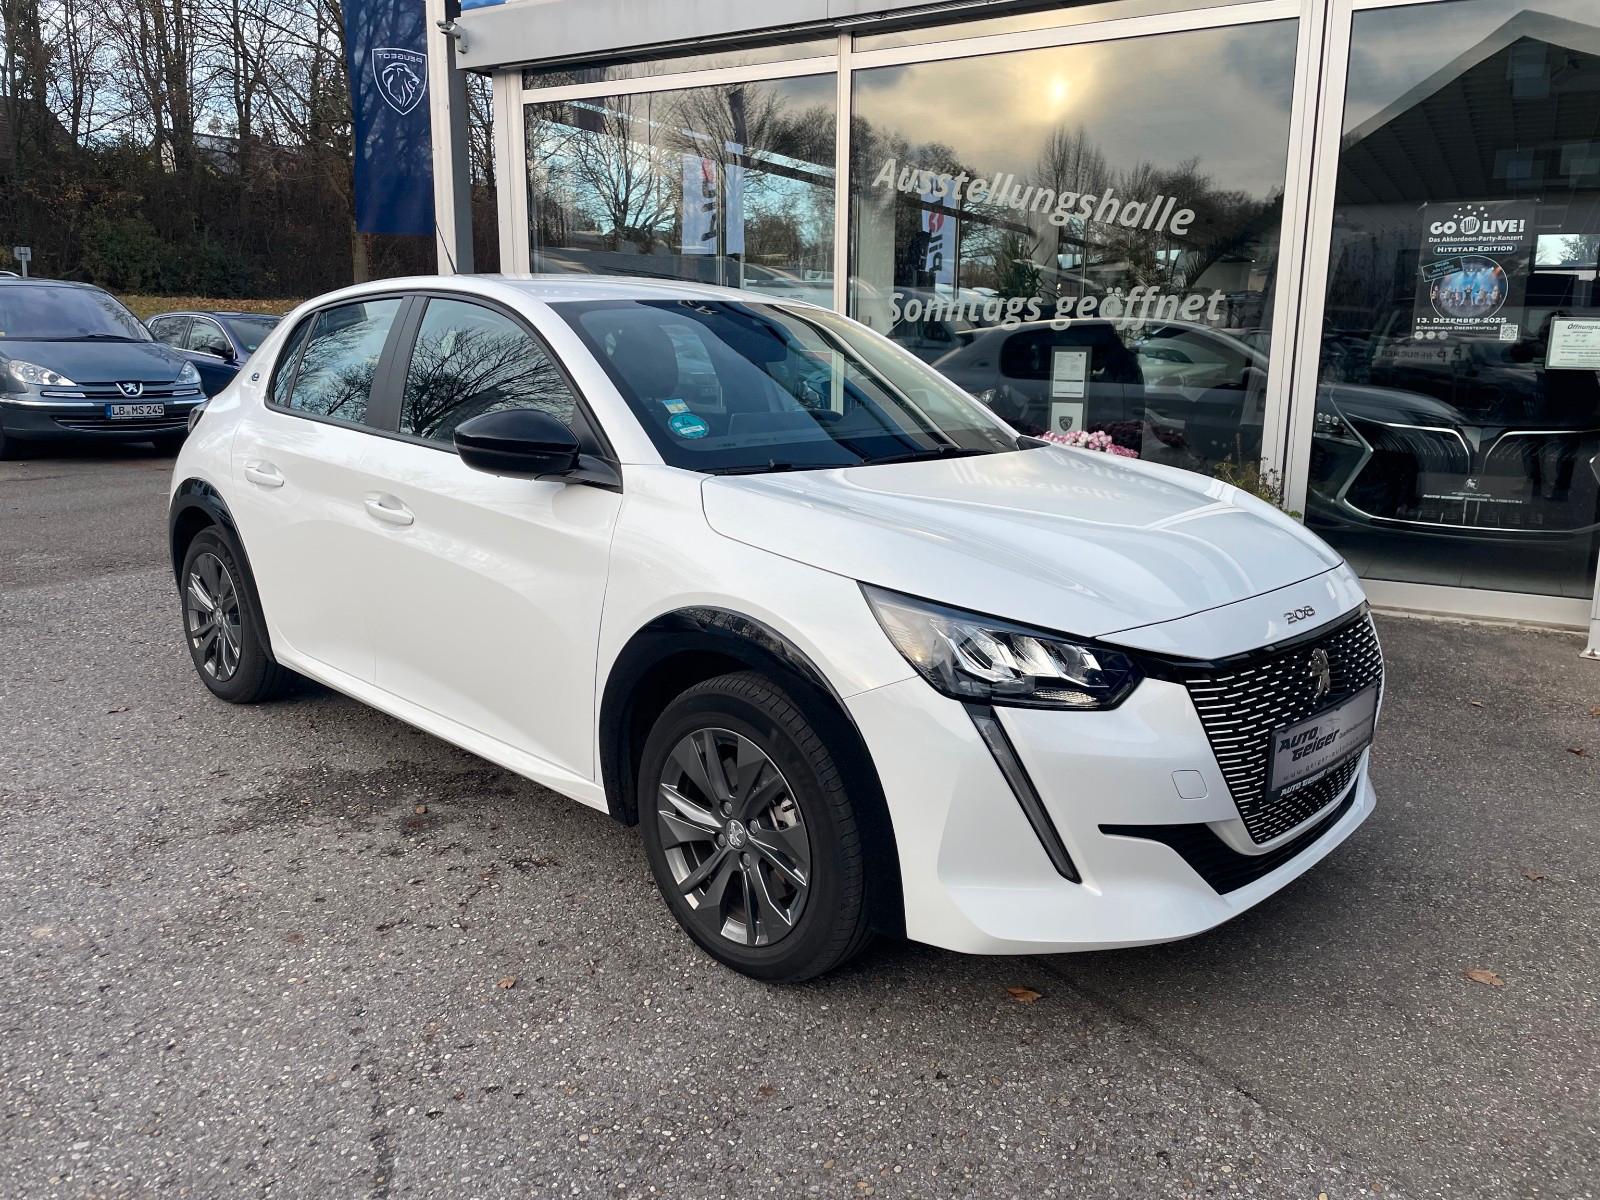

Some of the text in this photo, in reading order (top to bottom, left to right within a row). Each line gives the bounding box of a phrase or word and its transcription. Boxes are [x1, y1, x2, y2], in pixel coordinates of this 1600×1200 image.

[872, 158, 1196, 236] Ausstellungshalle
[1430, 219, 1526, 235] GO LIVE!
[1441, 235, 1523, 243] Akkordeon-Party-Konzert
[888, 285, 1226, 331] Sonntags geöffnet
[112, 403, 164, 416] LB MS 245
[1283, 605, 1316, 625] 208
[1279, 726, 1319, 753] AUTO
